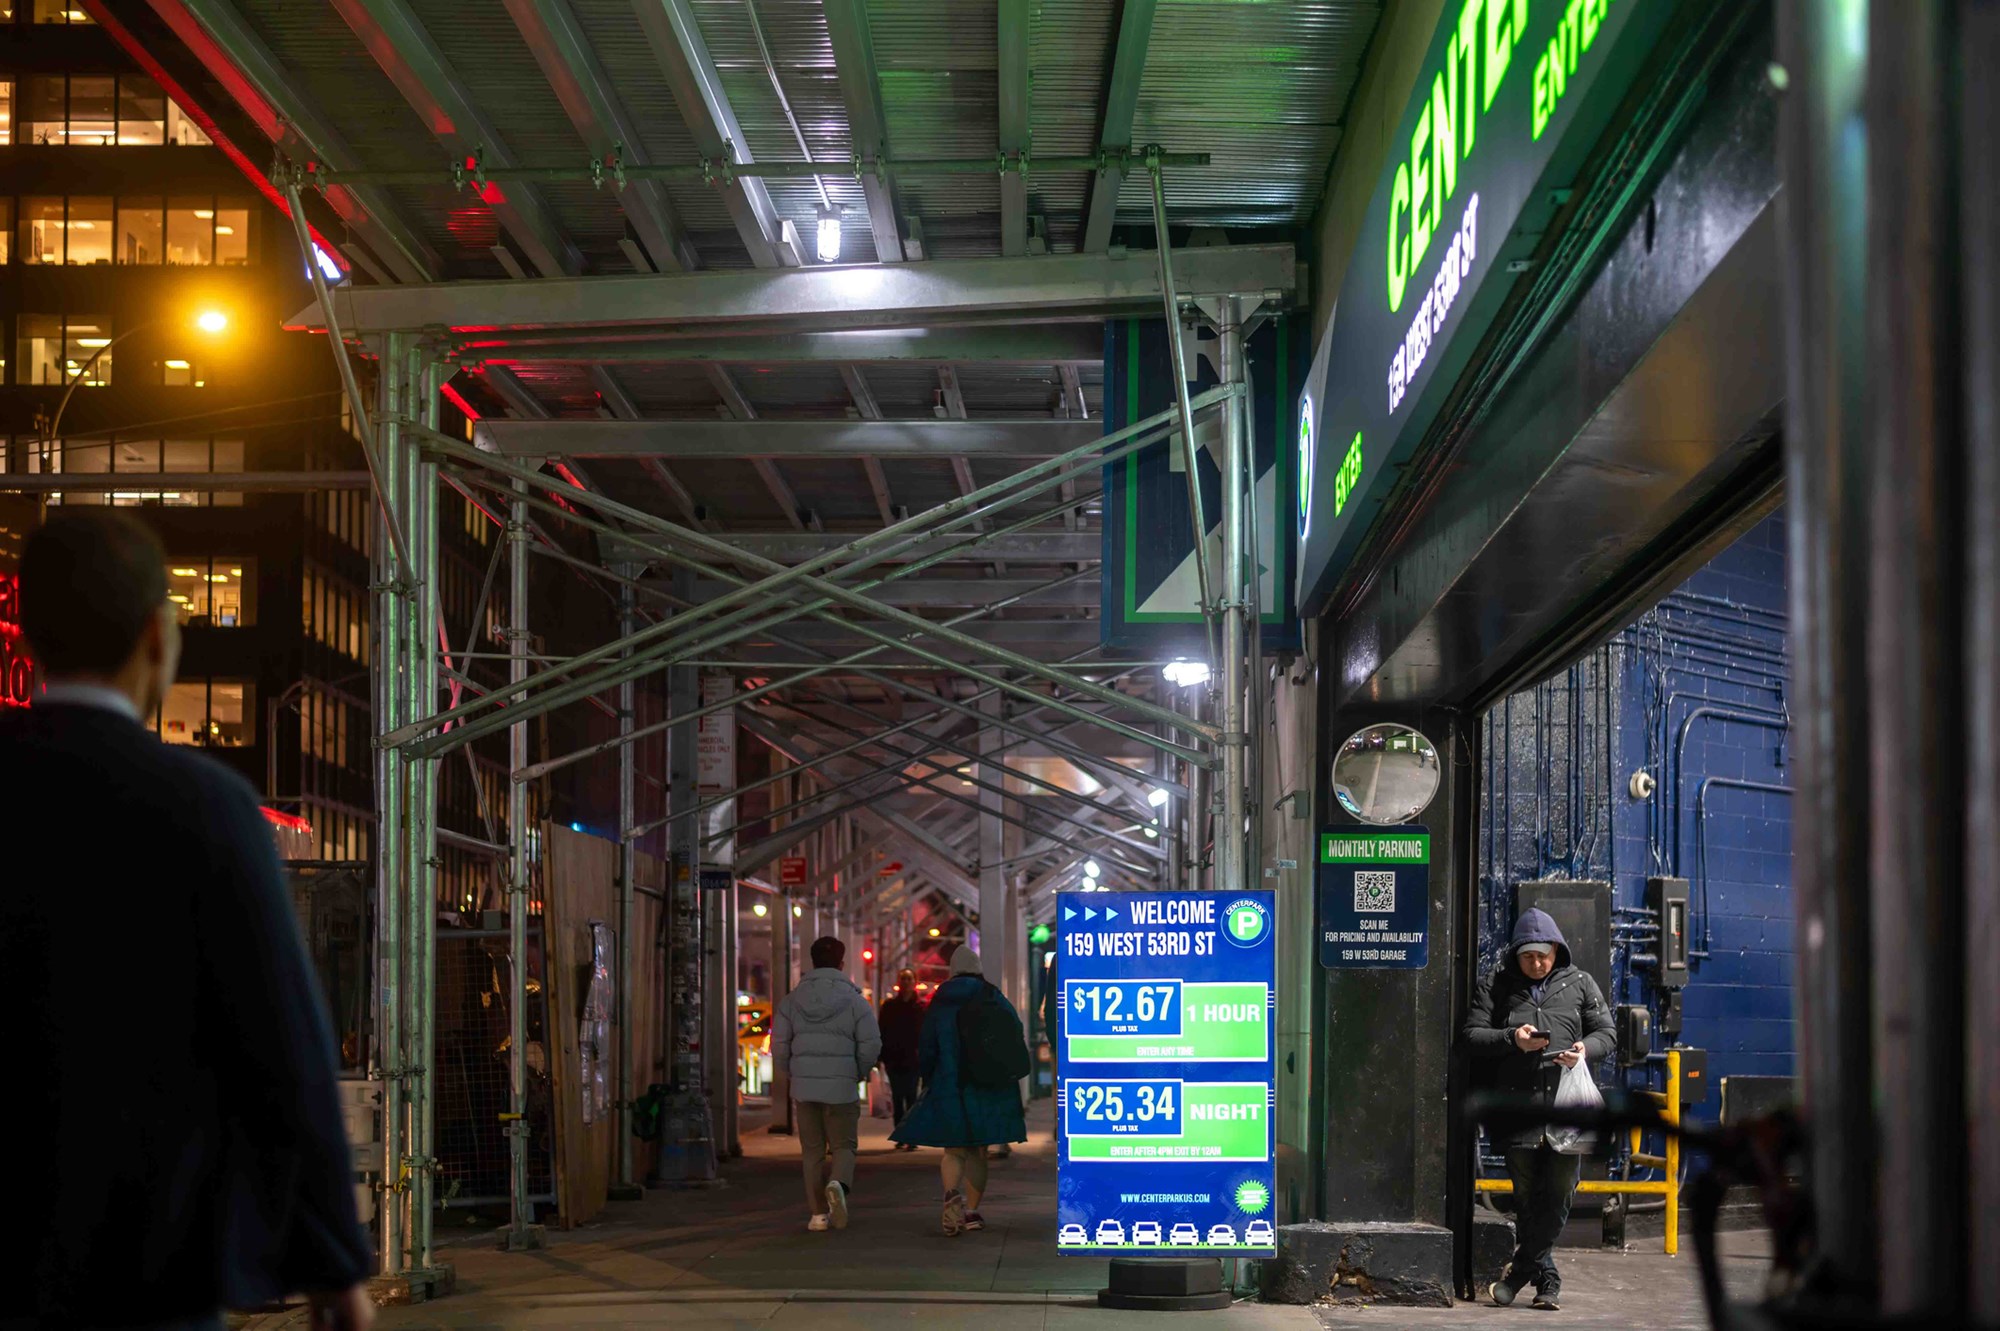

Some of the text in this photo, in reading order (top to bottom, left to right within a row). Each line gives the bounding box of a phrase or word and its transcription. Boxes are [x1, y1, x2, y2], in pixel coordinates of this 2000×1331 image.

[1532, 0, 1608, 142] ENTE
[1387, 0, 1528, 313] CENTE
[1405, 288, 1433, 384] WEST
[1461, 192, 1479, 278] ST
[1334, 431, 1362, 517] ENTER
[1328, 840, 1422, 858] MONTHLY PARKING
[1130, 900, 1215, 924] WELCOME
[1226, 899, 1266, 915] CENTERPARK
[1238, 911, 1258, 936] P
[1360, 919, 1388, 930] SCAN ME
[1065, 931, 1215, 956] 159 WEST 53RD ST
[1325, 932, 1423, 943] FOR PRICING AND AVAILABILITY
[1342, 949, 1406, 960] 159 W 53RD GARAGE
[1074, 986, 1174, 1022] $12.67
[1186, 1004, 1261, 1022] 1 HOUR
[1136, 1047, 1159, 1056] ENTER
[1074, 1085, 1175, 1121] $25.34
[1190, 1104, 1261, 1120] NIGHT
[1110, 1146, 1133, 1156] ENTER
[1134, 1146, 1156, 1156] AFTER
[1120, 1193, 1210, 1203] WWW.CENTERPARKUS.COM
